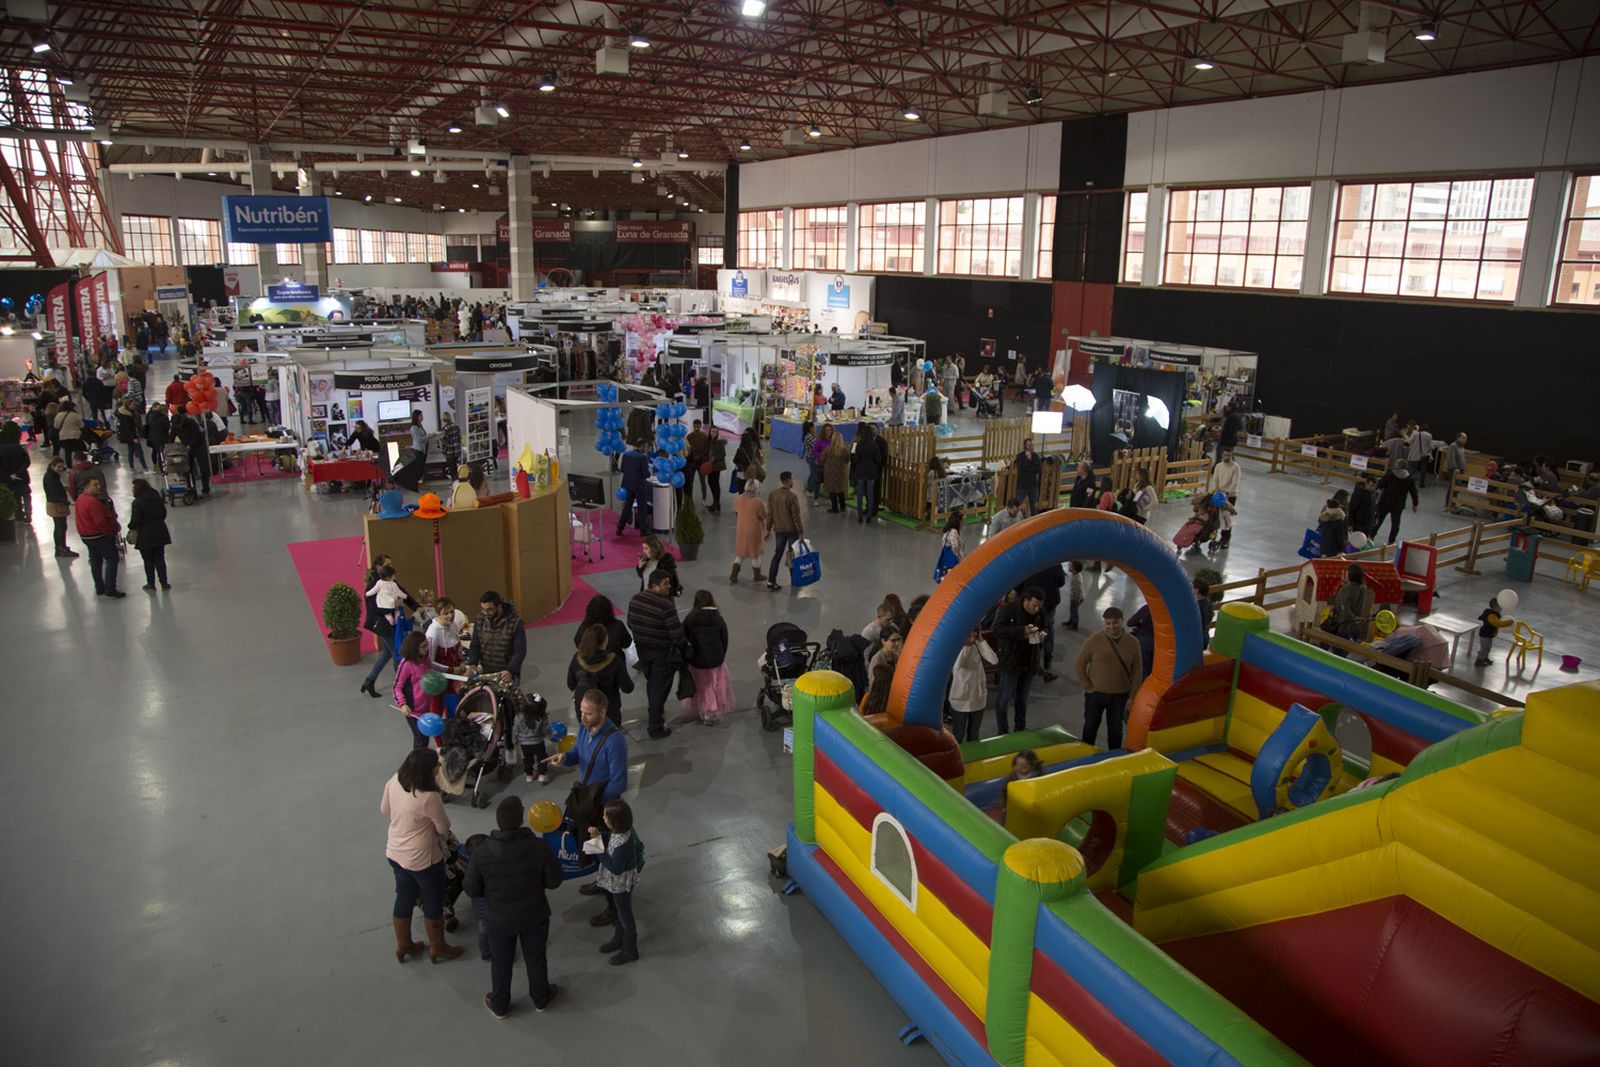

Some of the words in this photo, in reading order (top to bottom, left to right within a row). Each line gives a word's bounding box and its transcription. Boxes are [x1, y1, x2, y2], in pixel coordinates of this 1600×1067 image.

[235, 205, 319, 225] Nutribén
[534, 229, 570, 238] Granada
[617, 231, 638, 239] Luna
[639, 231, 651, 239] de
[652, 230, 689, 239] Granada
